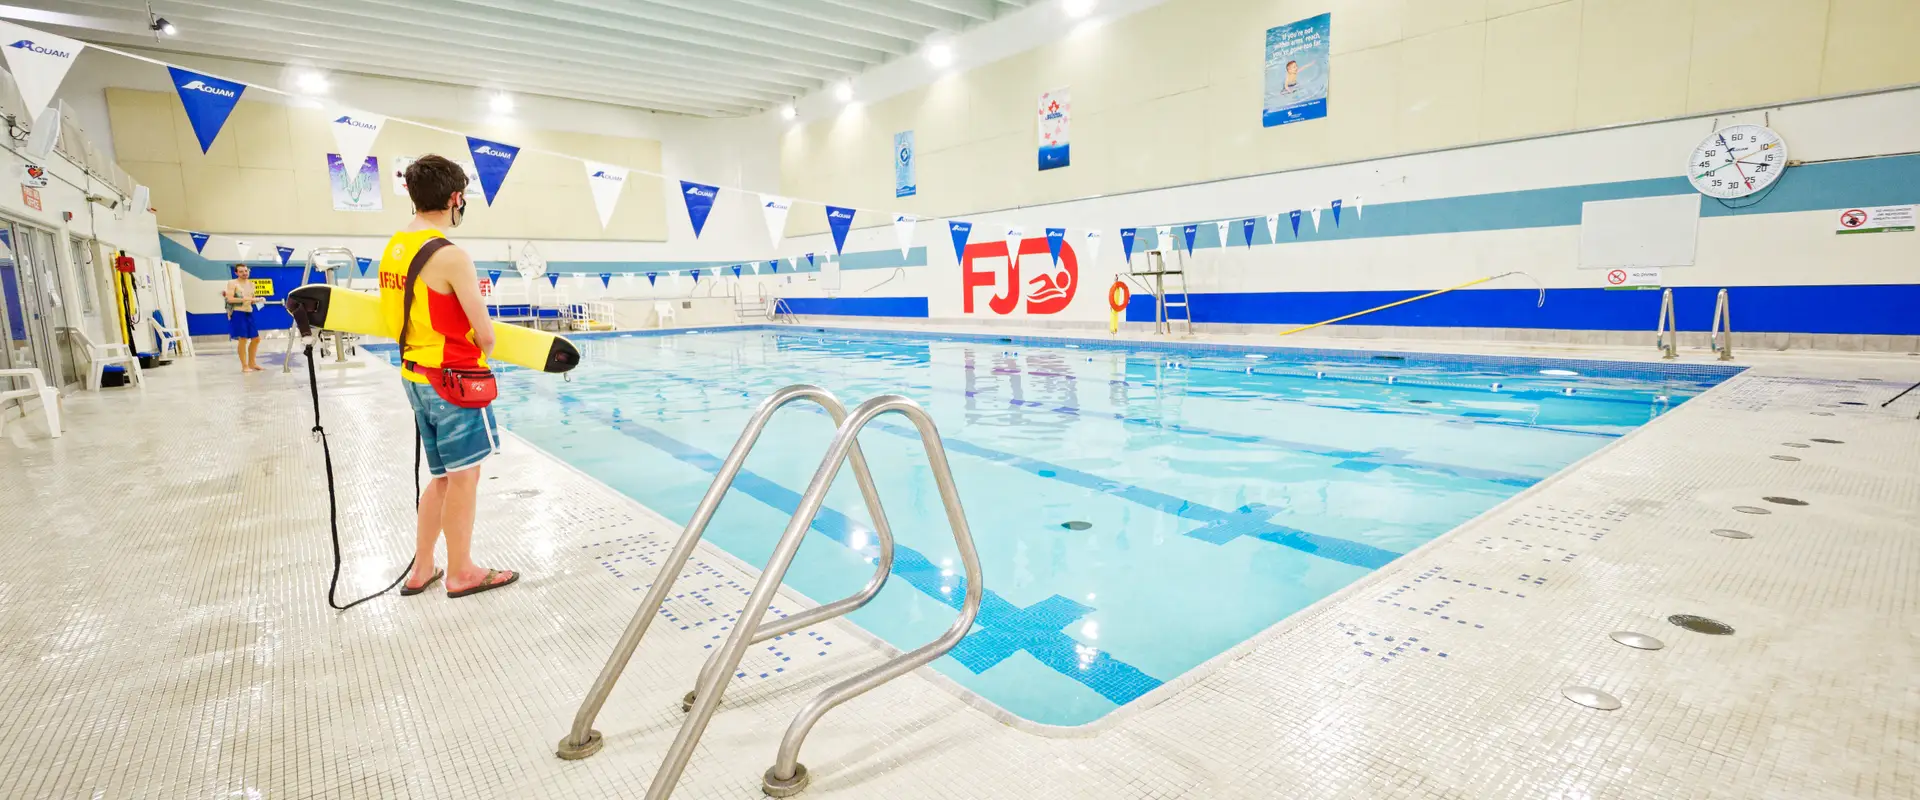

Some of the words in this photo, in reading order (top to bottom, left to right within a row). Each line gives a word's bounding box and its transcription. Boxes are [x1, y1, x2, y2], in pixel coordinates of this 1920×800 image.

[6, 39, 70, 59] AQUAM
[181, 80, 235, 98] AQUAM
[333, 115, 377, 131] AQUAM
[474, 145, 512, 160] AQUAM
